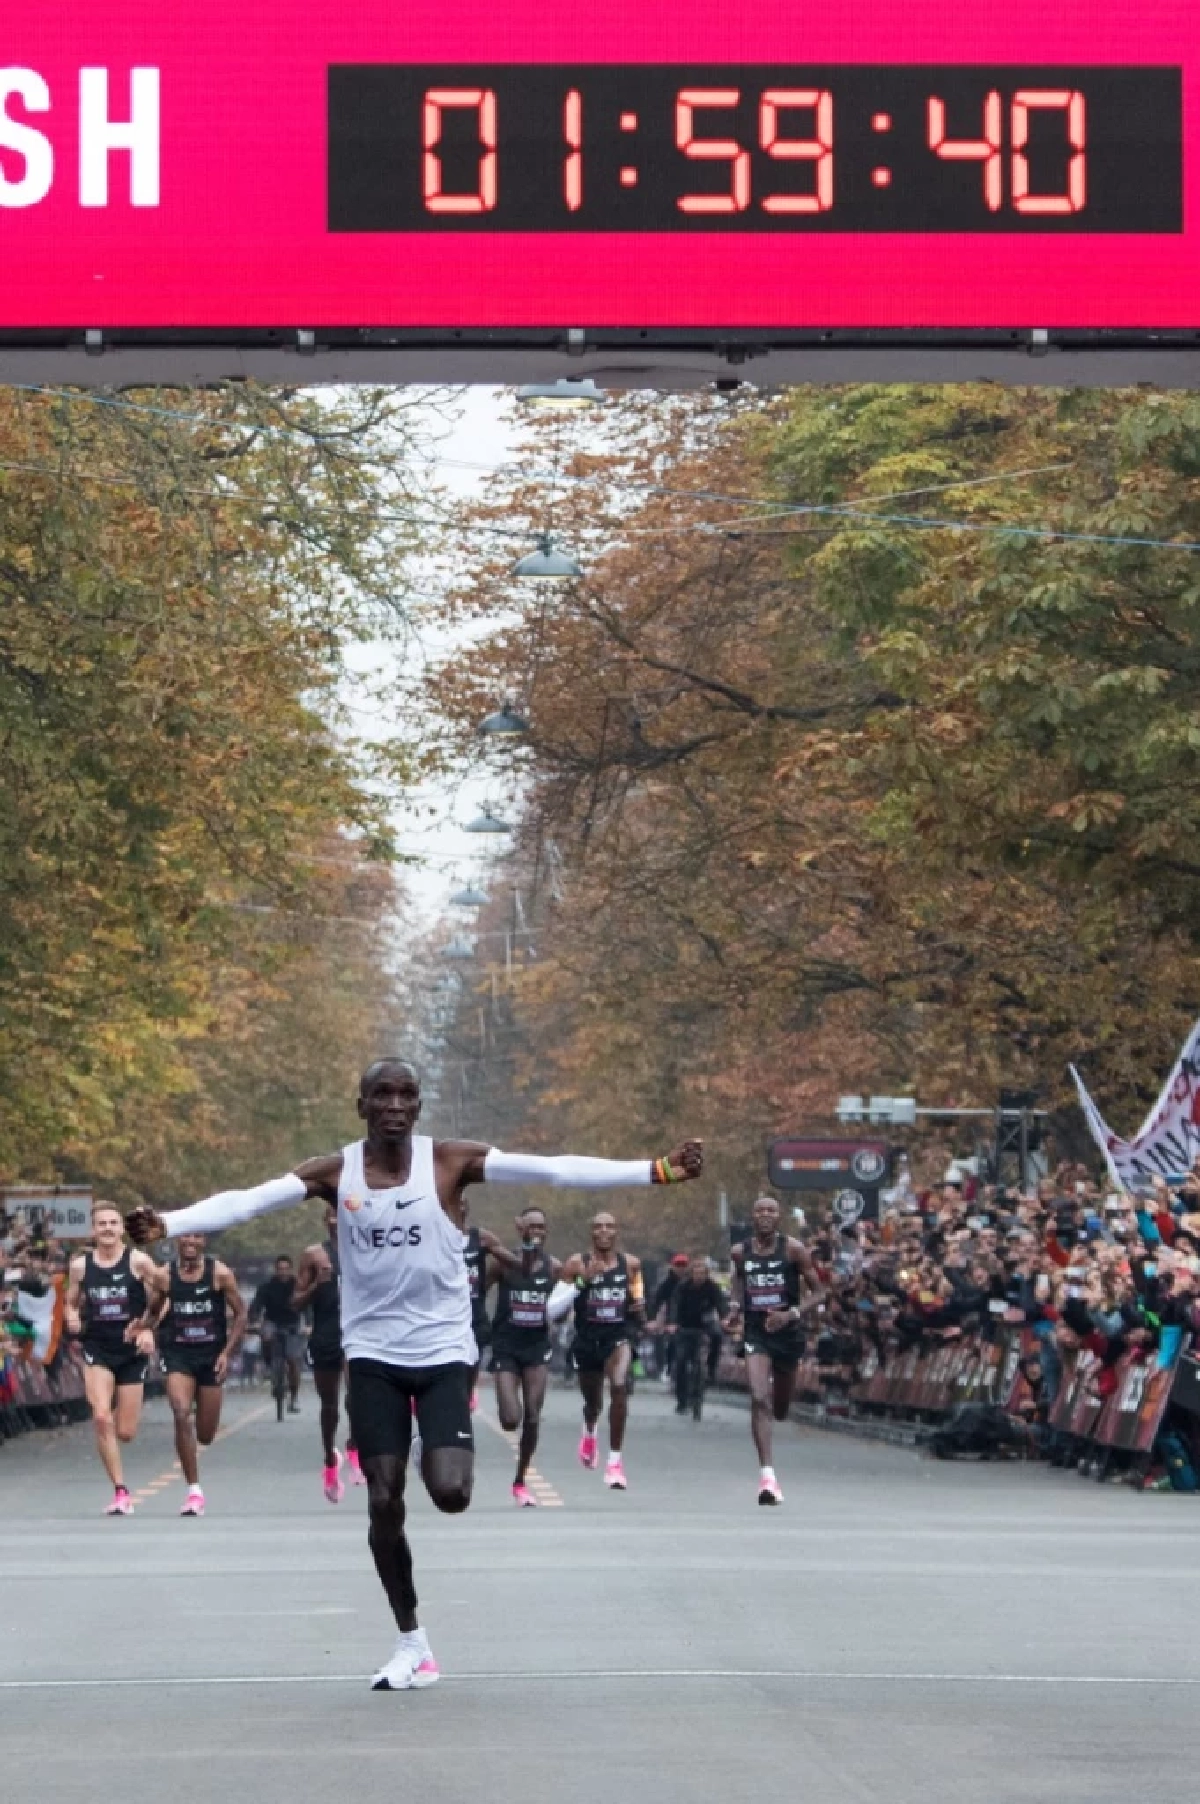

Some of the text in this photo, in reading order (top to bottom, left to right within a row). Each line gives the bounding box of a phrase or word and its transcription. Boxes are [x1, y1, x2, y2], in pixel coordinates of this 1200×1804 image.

[0, 66, 160, 207] SH
[422, 87, 1086, 213] 01:59:40
[350, 1224, 422, 1248] INEOS
